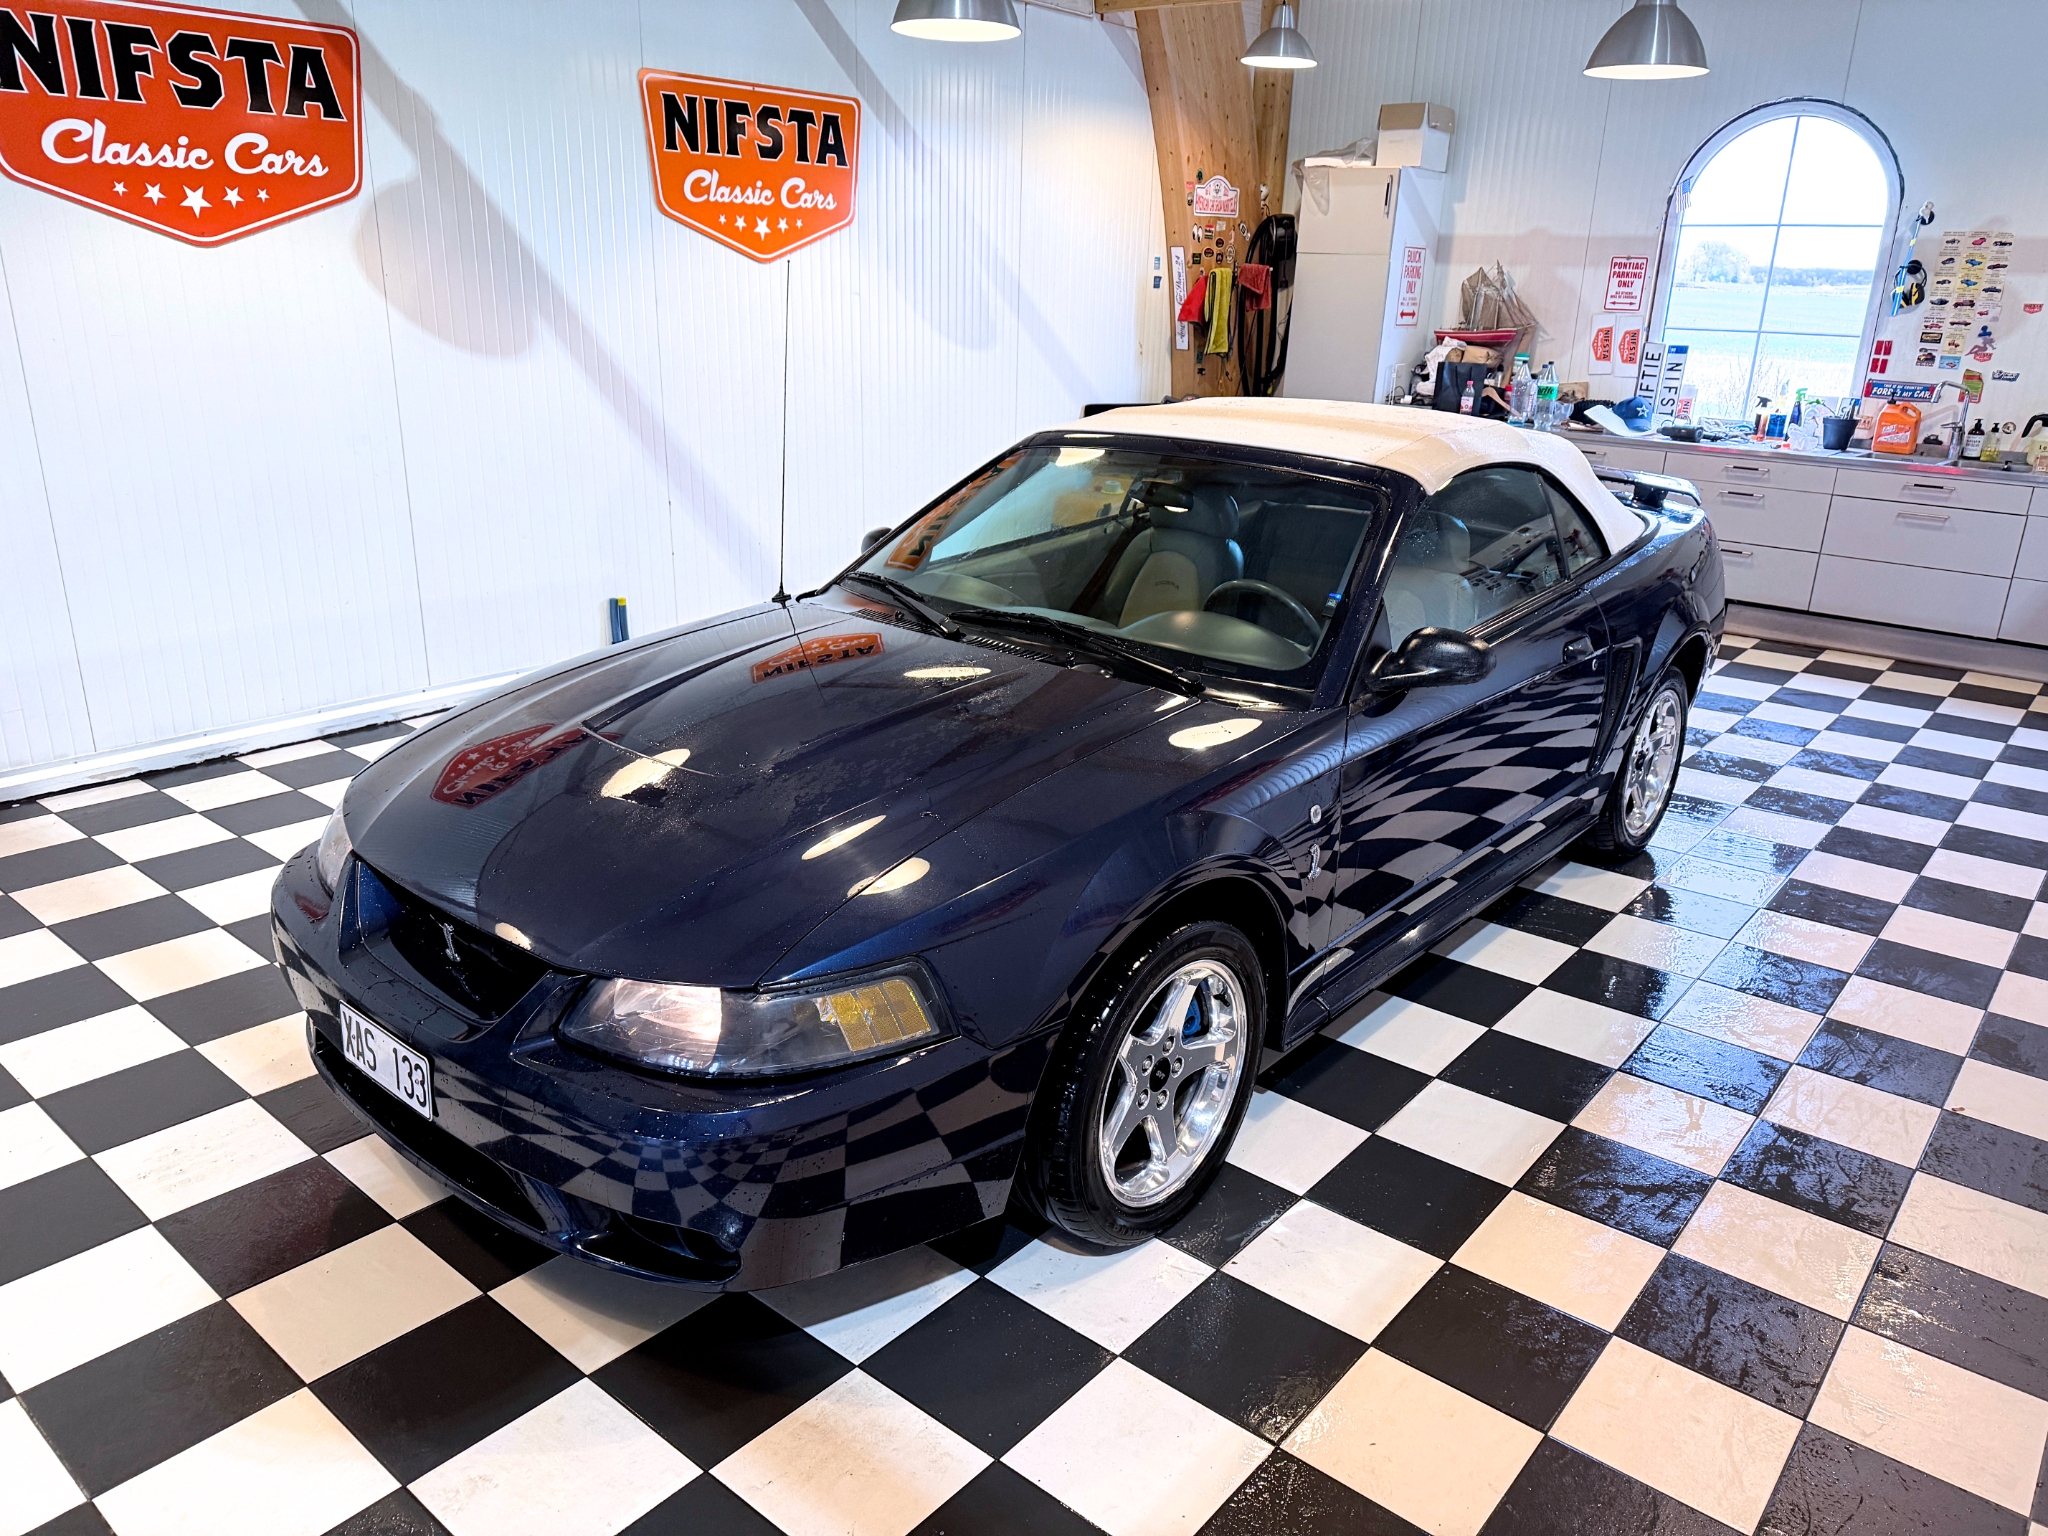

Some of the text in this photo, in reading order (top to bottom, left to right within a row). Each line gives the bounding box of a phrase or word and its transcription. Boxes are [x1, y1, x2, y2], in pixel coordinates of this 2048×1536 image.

[0, 8, 347, 121] NIFSTA
[660, 91, 850, 168] NIFSTA
[41, 118, 329, 177] Classic Cars
[683, 168, 837, 210] Classic Cars
[1407, 250, 1421, 263] BUICK
[1613, 262, 1645, 270] PONTIAC
[1404, 265, 1421, 279] PARKING
[1406, 281, 1417, 293] ONLY
[1612, 271, 1642, 279] PARKING
[1617, 280, 1634, 288] ONLY
[1602, 329, 1610, 360] NIFSTA
[1628, 332, 1637, 362] NIFSTA
[1638, 351, 1662, 405] IFTIE
[1872, 386, 1893, 396] FORD
[342, 1010, 427, 1108] XAS 133
